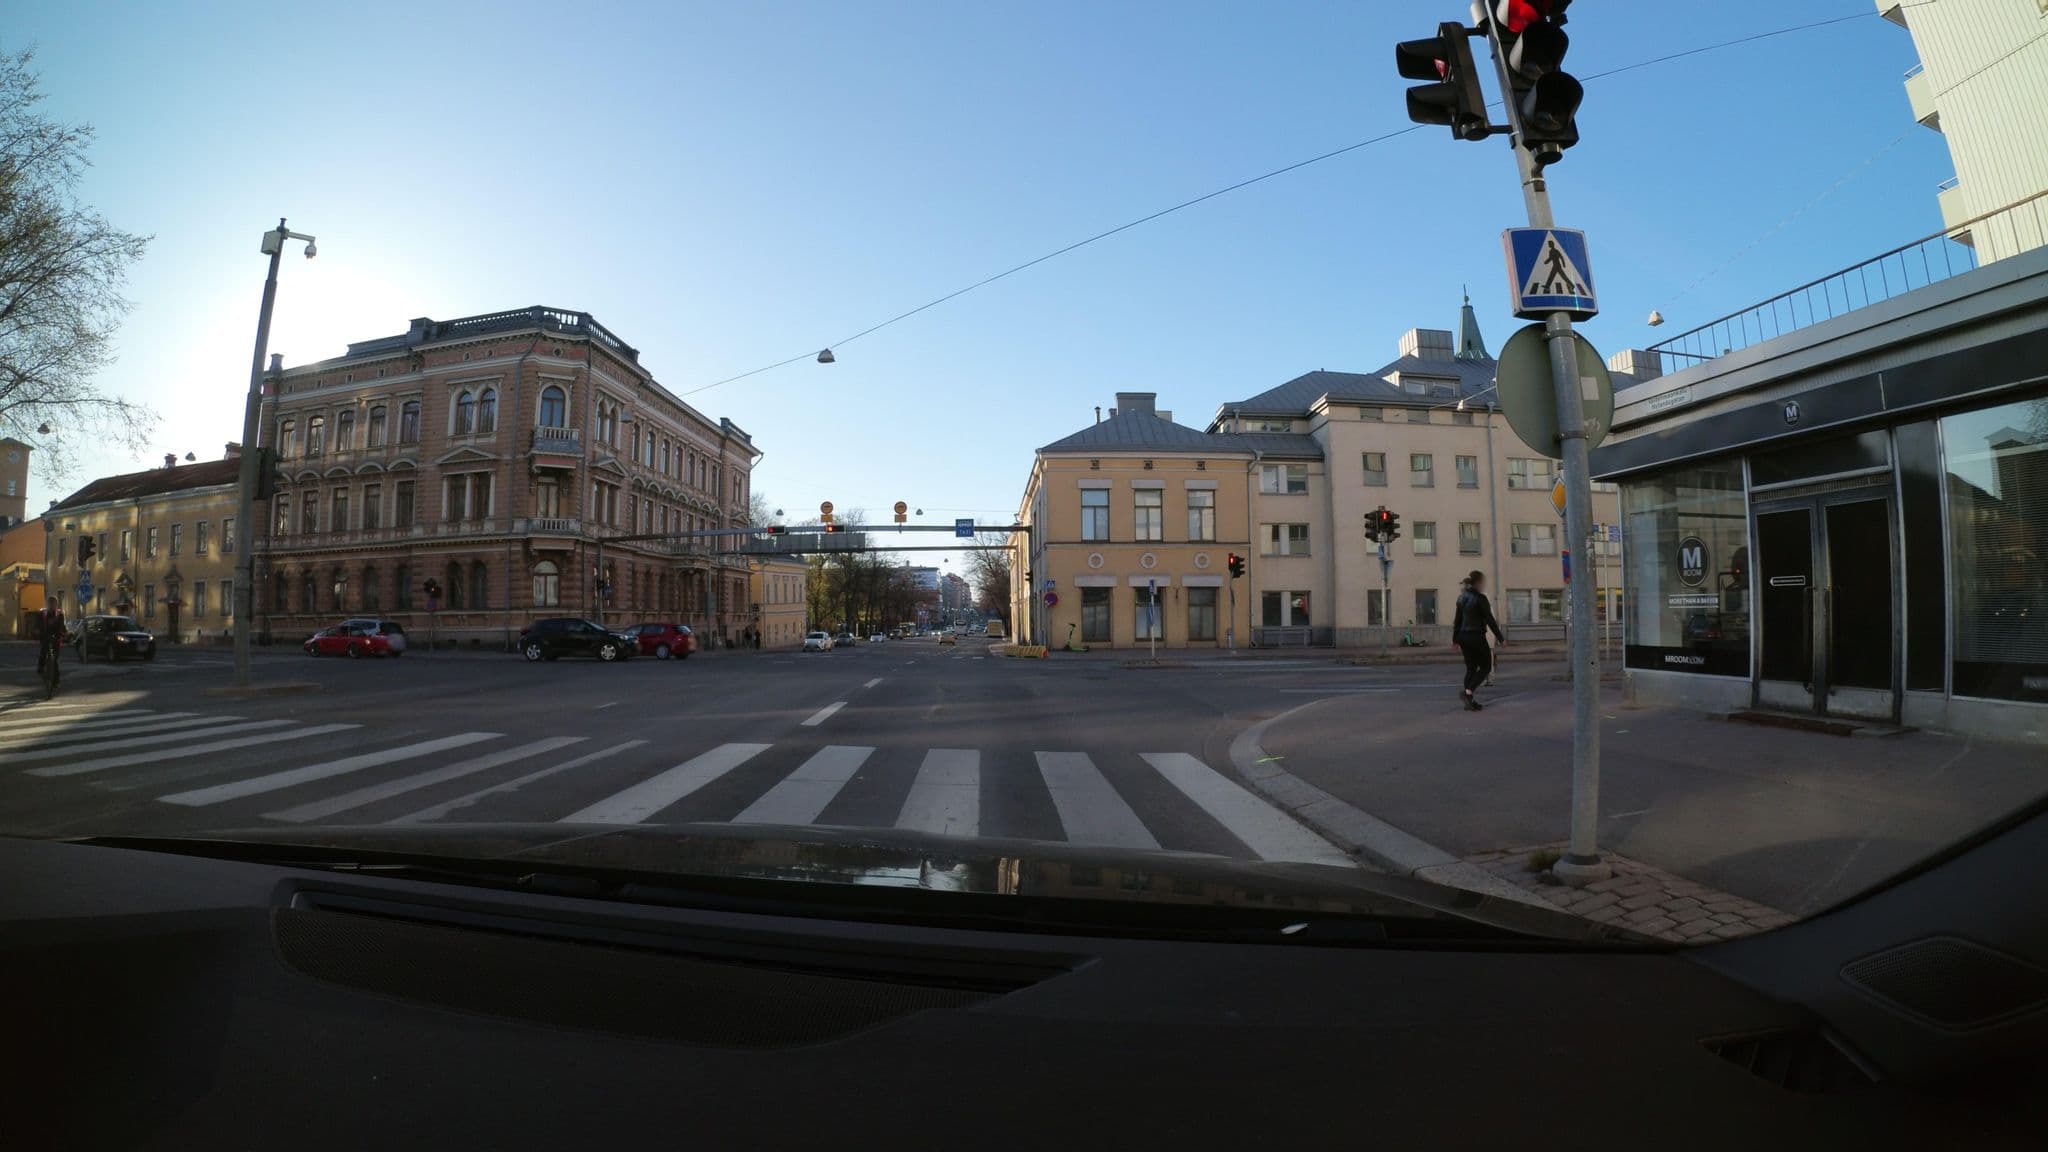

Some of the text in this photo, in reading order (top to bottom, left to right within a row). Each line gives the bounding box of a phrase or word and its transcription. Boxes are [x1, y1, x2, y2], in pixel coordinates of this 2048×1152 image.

[1786, 405, 1797, 418] M
[1682, 546, 1701, 569] M
[1683, 568, 1702, 577] ROOM
